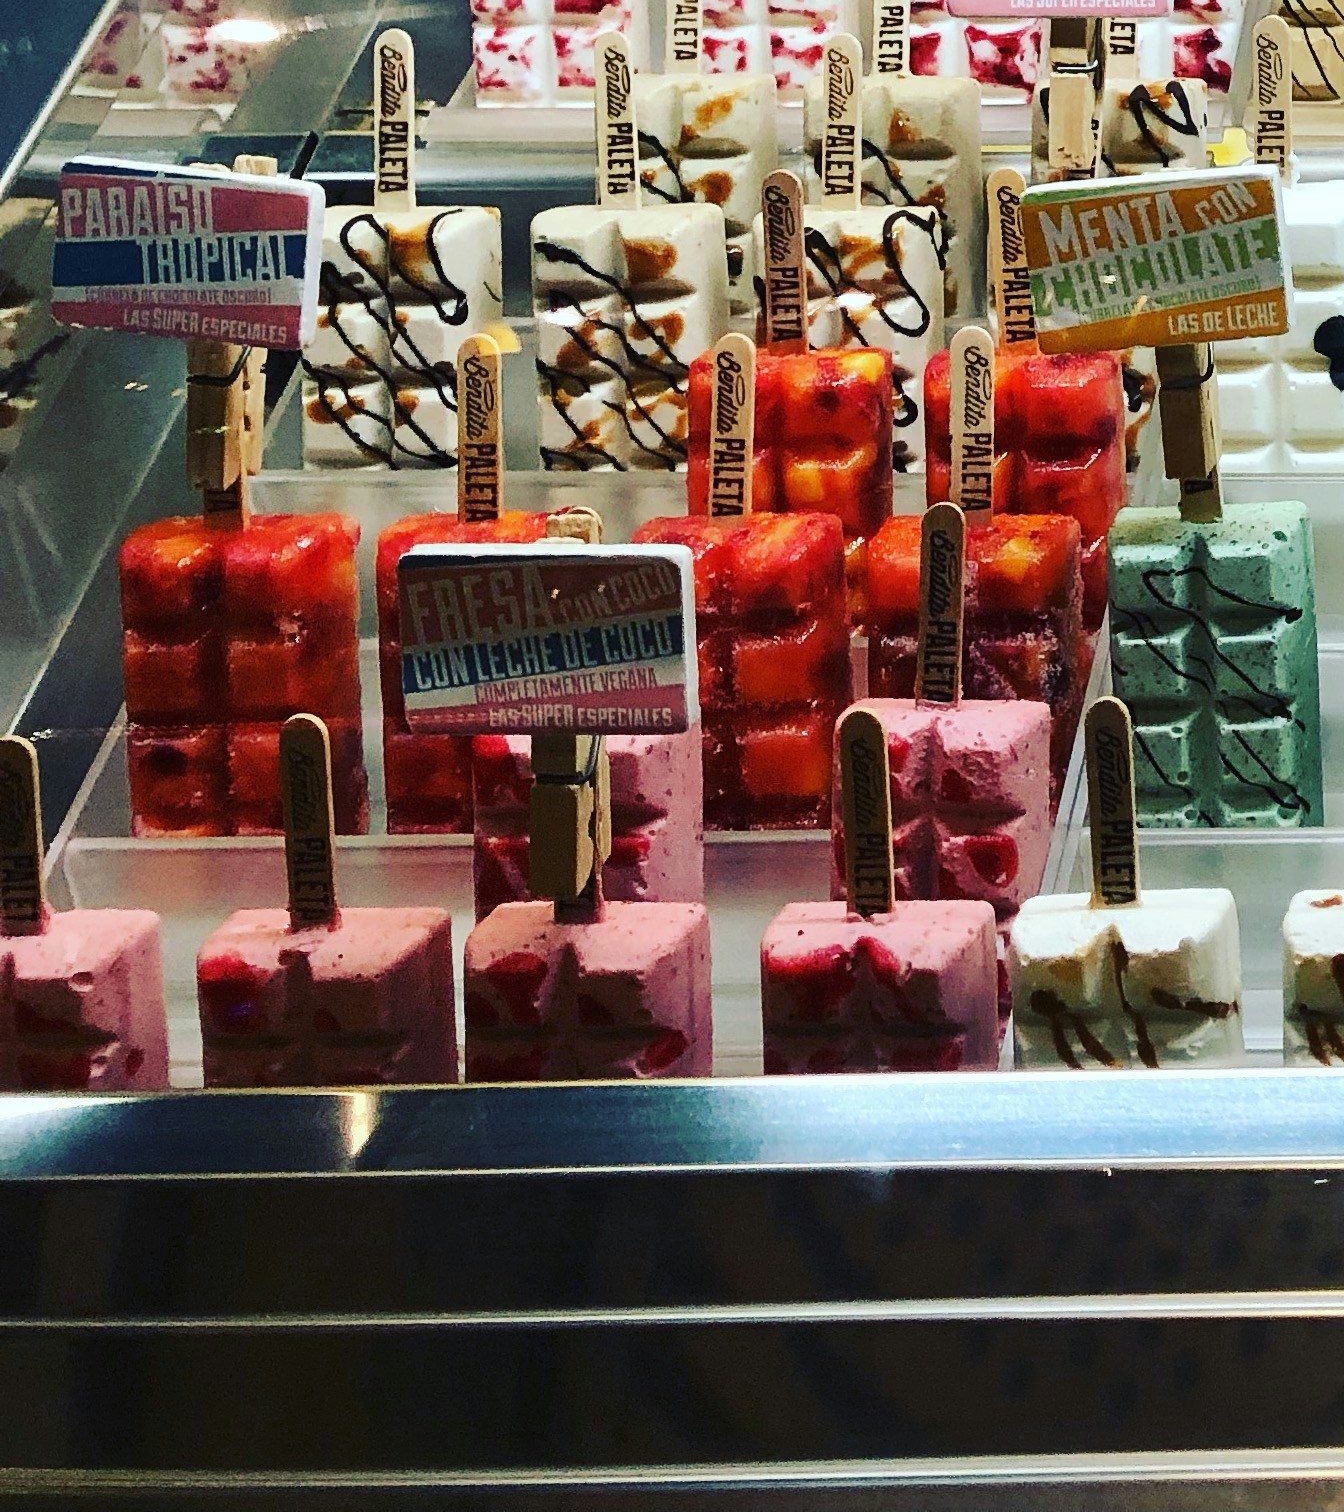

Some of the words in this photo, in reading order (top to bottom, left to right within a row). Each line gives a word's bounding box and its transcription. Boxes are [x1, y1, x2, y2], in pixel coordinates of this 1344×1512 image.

[378, 120, 409, 193] PALETA
[606, 122, 633, 195] PALETA
[136, 234, 295, 286] TROPICAL
[1038, 192, 1186, 269] MENTA
[1194, 181, 1257, 228] CON
[1042, 224, 1264, 315] CHOCOLATE
[461, 442, 499, 521] PALETA
[407, 565, 556, 646] FRESA
[413, 642, 469, 688] CON
[473, 629, 559, 680] LECHE
[561, 629, 599, 669] DE
[602, 617, 673, 660] COCO
[475, 672, 599, 703] COMPLETAMENTE
[600, 667, 659, 692] VEGANA
[489, 708, 519, 728] LAS
[521, 704, 574, 727] SUPER
[577, 707, 672, 728] ESPECIALES
